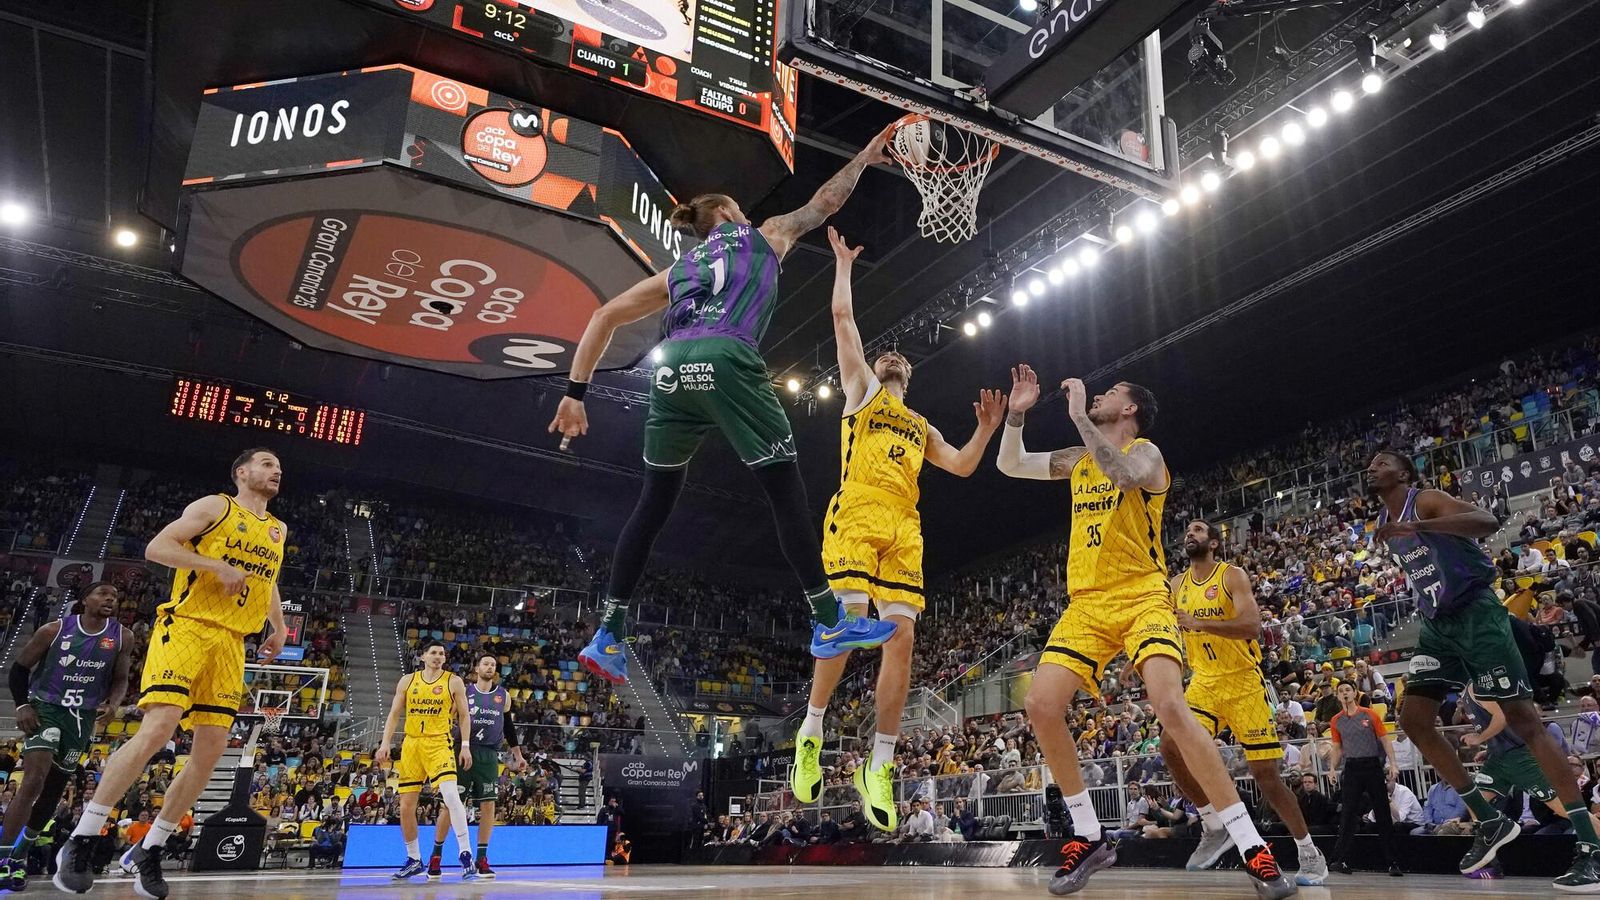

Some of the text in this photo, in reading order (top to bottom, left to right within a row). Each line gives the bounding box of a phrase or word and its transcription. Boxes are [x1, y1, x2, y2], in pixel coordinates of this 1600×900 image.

[484, 4, 526, 30] 9:12
[494, 30, 515, 42] acb
[577, 49, 630, 76] CUARTO 1
[690, 67, 713, 79] COACH
[701, 95, 746, 115] EQUIPO 0
[702, 88, 733, 104] FALTAS
[230, 100, 350, 147] IONOS
[485, 127, 506, 136] acb
[476, 132, 516, 150] Copa
[492, 147, 522, 167] Rey
[632, 182, 682, 260] IONOS
[315, 218, 348, 252] Gran
[298, 252, 335, 296] Canaria
[708, 258, 725, 296] 1
[327, 249, 425, 325] del Rey
[409, 259, 497, 331] Copa
[476, 288, 525, 324] acb
[679, 363, 715, 374] COSTA
[680, 374, 715, 383] DEL SOL
[266, 391, 289, 403] 9:12
[244, 403, 252, 412] 2
[298, 412, 305, 422] 0
[888, 445, 906, 465] 42
[1074, 483, 1115, 496] LA LAGU
[1087, 523, 1102, 548] 35
[226, 537, 279, 564] LA LAGUNA
[1400, 545, 1430, 564] Unicaja
[237, 585, 250, 607] 9
[1424, 580, 1442, 608] 77
[1203, 643, 1217, 660] 11
[61, 689, 85, 707] 55
[480, 708, 500, 716] Unicaja
[420, 720, 425, 733] 1
[476, 728, 485, 741] 4
[772, 756, 792, 765] endesa
[622, 767, 652, 778] Copa
[668, 768, 688, 781] Rey
